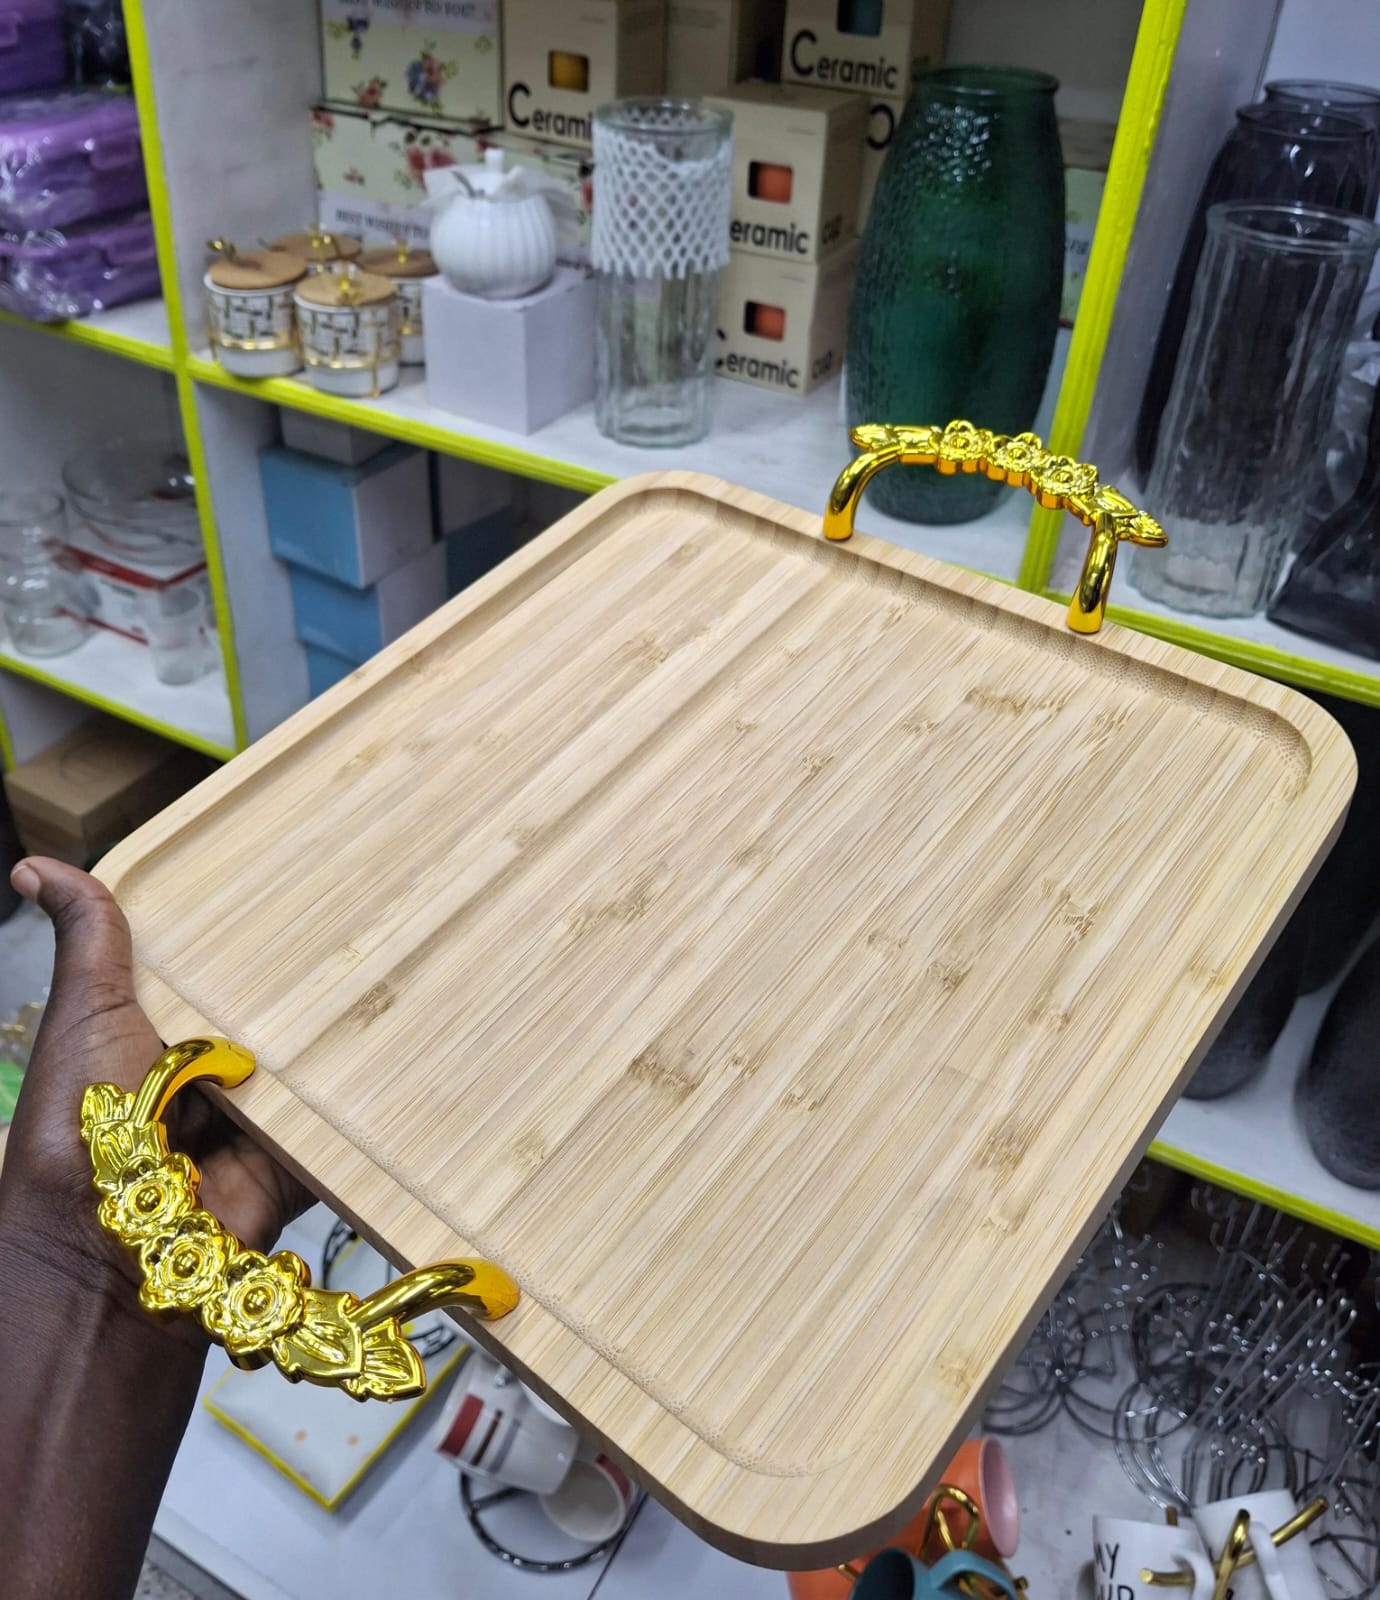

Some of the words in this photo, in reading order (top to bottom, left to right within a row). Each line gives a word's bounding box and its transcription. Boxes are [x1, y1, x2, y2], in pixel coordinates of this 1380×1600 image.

[790, 29, 898, 89] Ceramic
[508, 82, 593, 140] Cerami
[729, 219, 809, 254] eramic
[714, 328, 799, 389] eramic
